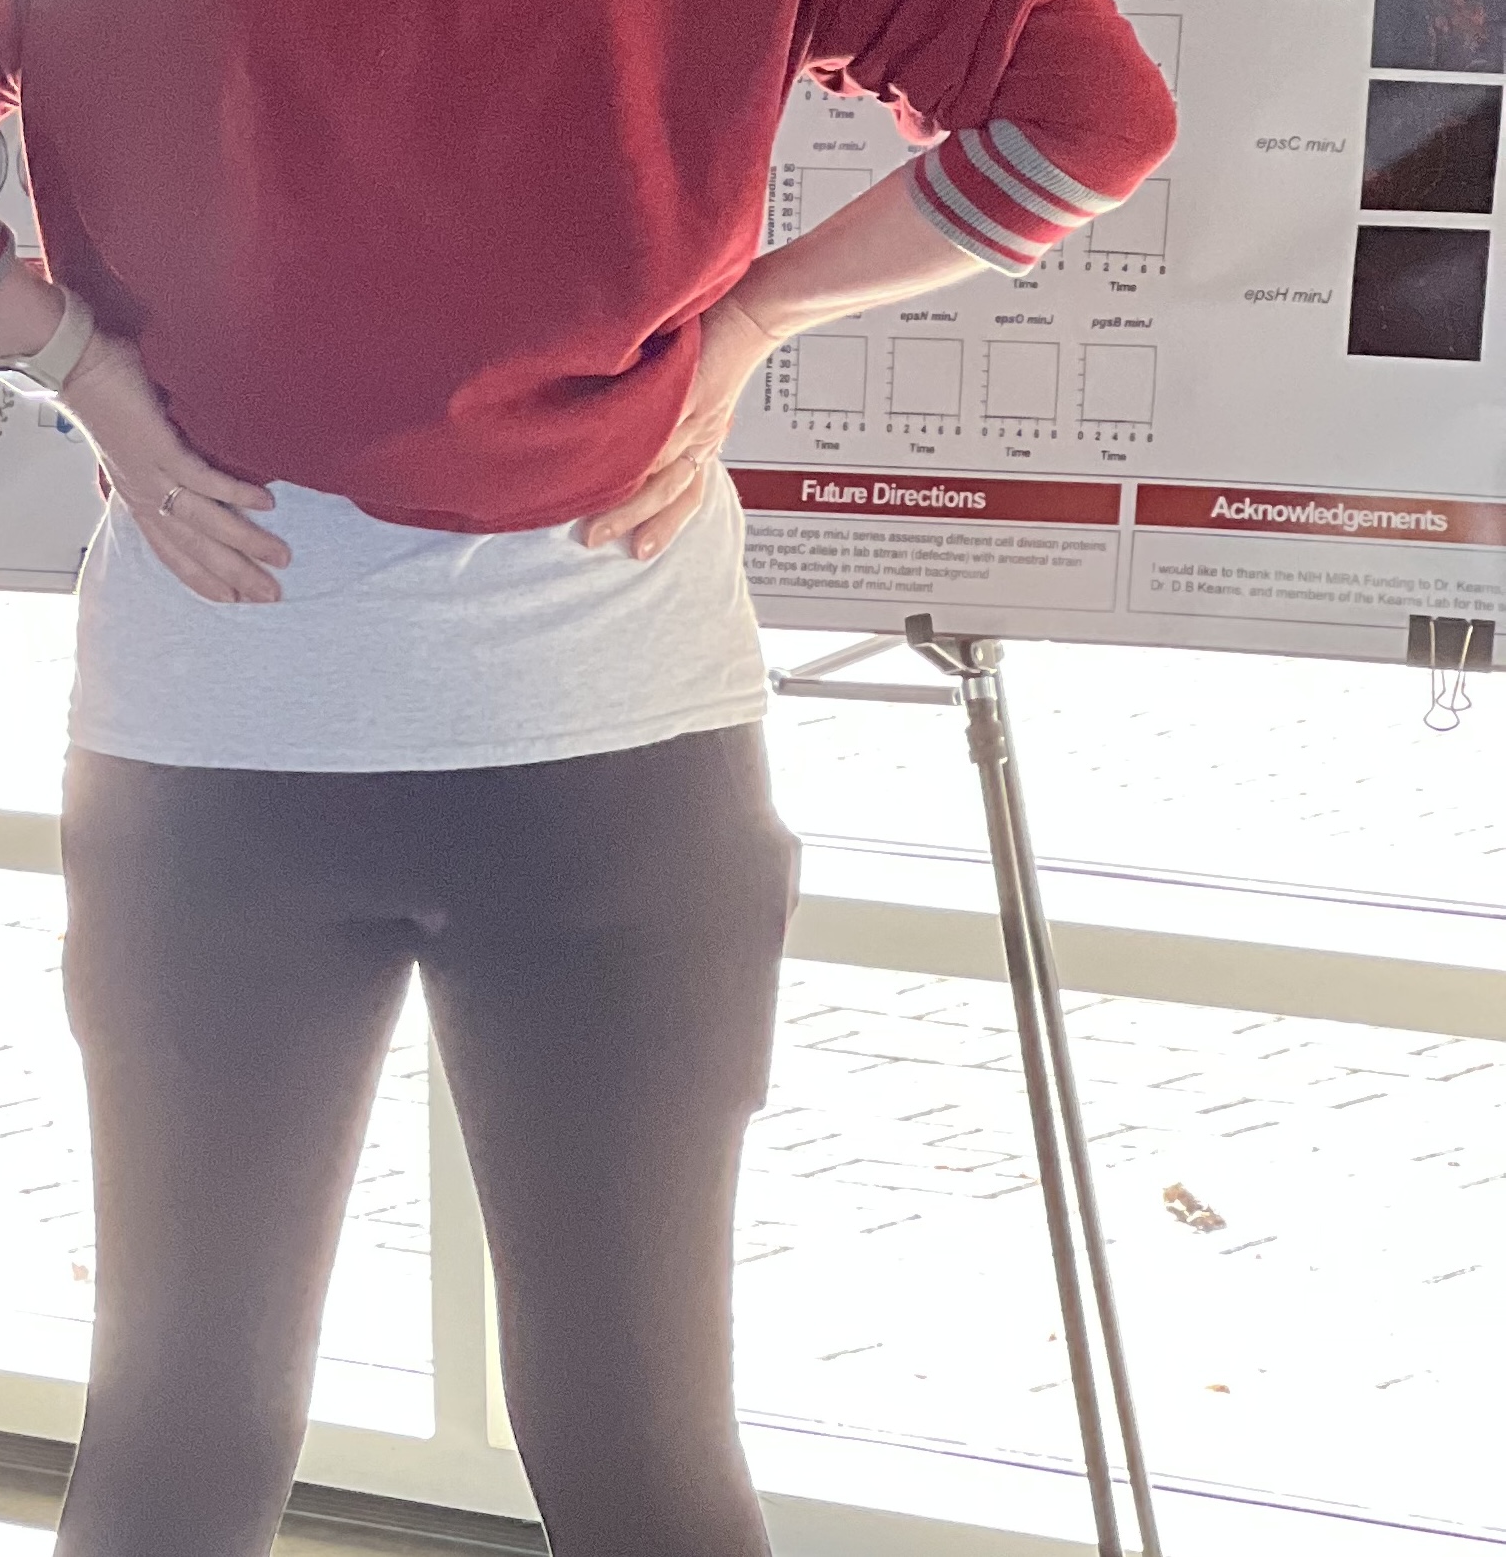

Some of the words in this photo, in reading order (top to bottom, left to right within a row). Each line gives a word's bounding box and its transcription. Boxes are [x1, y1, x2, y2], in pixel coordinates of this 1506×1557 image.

[828, 108, 854, 119] Time
[1256, 136, 1301, 152] epsC
[1305, 138, 1346, 153] minJ
[1109, 281, 1137, 292] Time
[1244, 287, 1289, 304] epsH
[1292, 289, 1332, 304] minJ
[815, 440, 840, 450] Time
[910, 443, 935, 454] Time
[1006, 446, 1031, 458] Time
[1101, 450, 1126, 461] Time
[802, 479, 868, 505] Future
[872, 483, 986, 510] Directions
[1211, 496, 1449, 533] Acknowledgements
[787, 526, 799, 538] of
[800, 529, 820, 542] eps
[823, 528, 850, 542] minJ
[888, 532, 944, 547] assessing
[946, 534, 993, 547] different
[1061, 538, 1106, 554] proteins
[854, 546, 871, 558] lab
[910, 548, 971, 563] (defective)
[972, 550, 995, 563] with
[998, 551, 1048, 566] ancestral
[1051, 553, 1082, 567] strain
[751, 557, 767, 569] for
[801, 559, 838, 575] activity
[854, 562, 881, 575] minJ
[884, 564, 922, 577] mutant
[924, 566, 990, 581] background
[1159, 563, 1194, 576] would
[1197, 565, 1218, 577] like
[1221, 567, 1234, 578] to
[1236, 568, 1271, 580] thank
[1275, 569, 1296, 581] the
[1298, 570, 1322, 583] NIH
[1325, 572, 1360, 585] MIRA
[1363, 574, 1415, 590] Funding
[1418, 578, 1431, 589] to
[779, 574, 850, 590] mutagenesis
[852, 577, 864, 590] of
[866, 578, 893, 591] minJ
[895, 579, 933, 593] mutant
